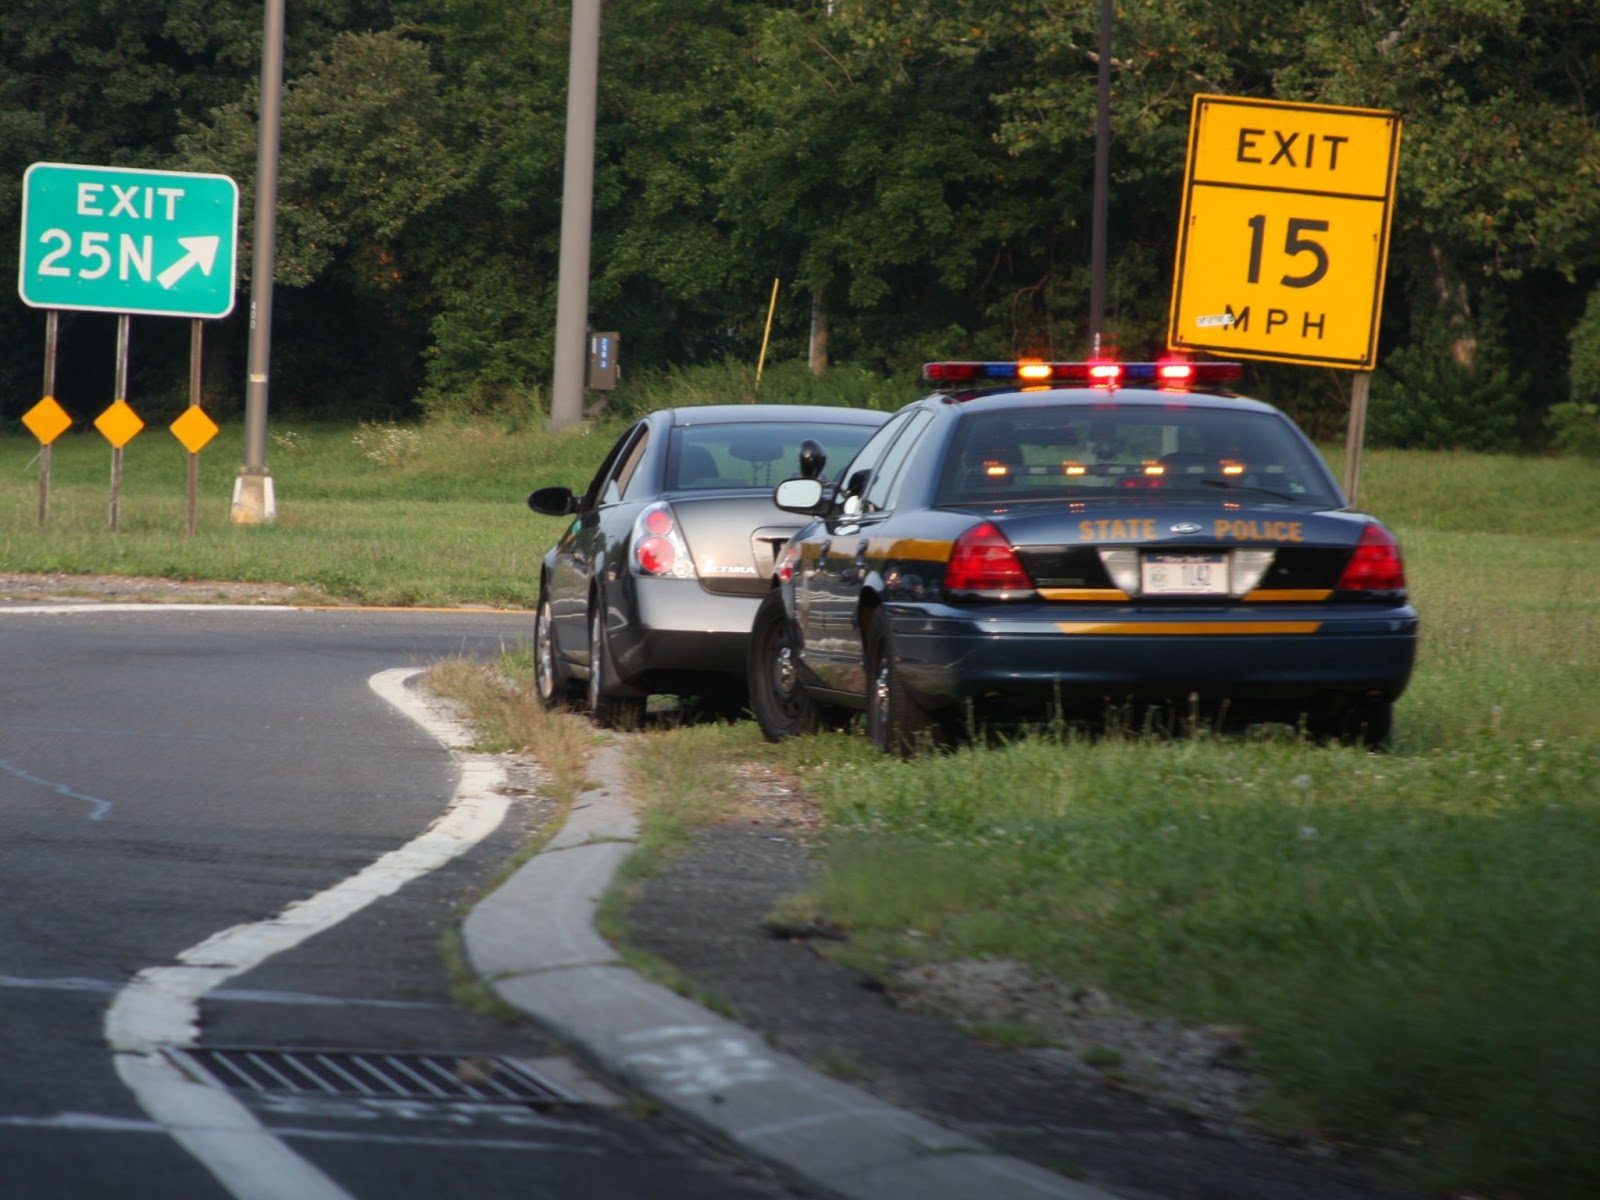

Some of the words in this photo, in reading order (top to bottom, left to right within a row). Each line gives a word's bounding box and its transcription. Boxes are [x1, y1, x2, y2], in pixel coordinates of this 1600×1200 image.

[1236, 127, 1349, 171] EXIT
[77, 182, 185, 221] EXIT
[38, 228, 153, 282] 25N
[1247, 214, 1329, 288] 15
[1223, 304, 1325, 340] MPH
[1078, 519, 1157, 541] STATE
[1214, 519, 1304, 542] POLICE
